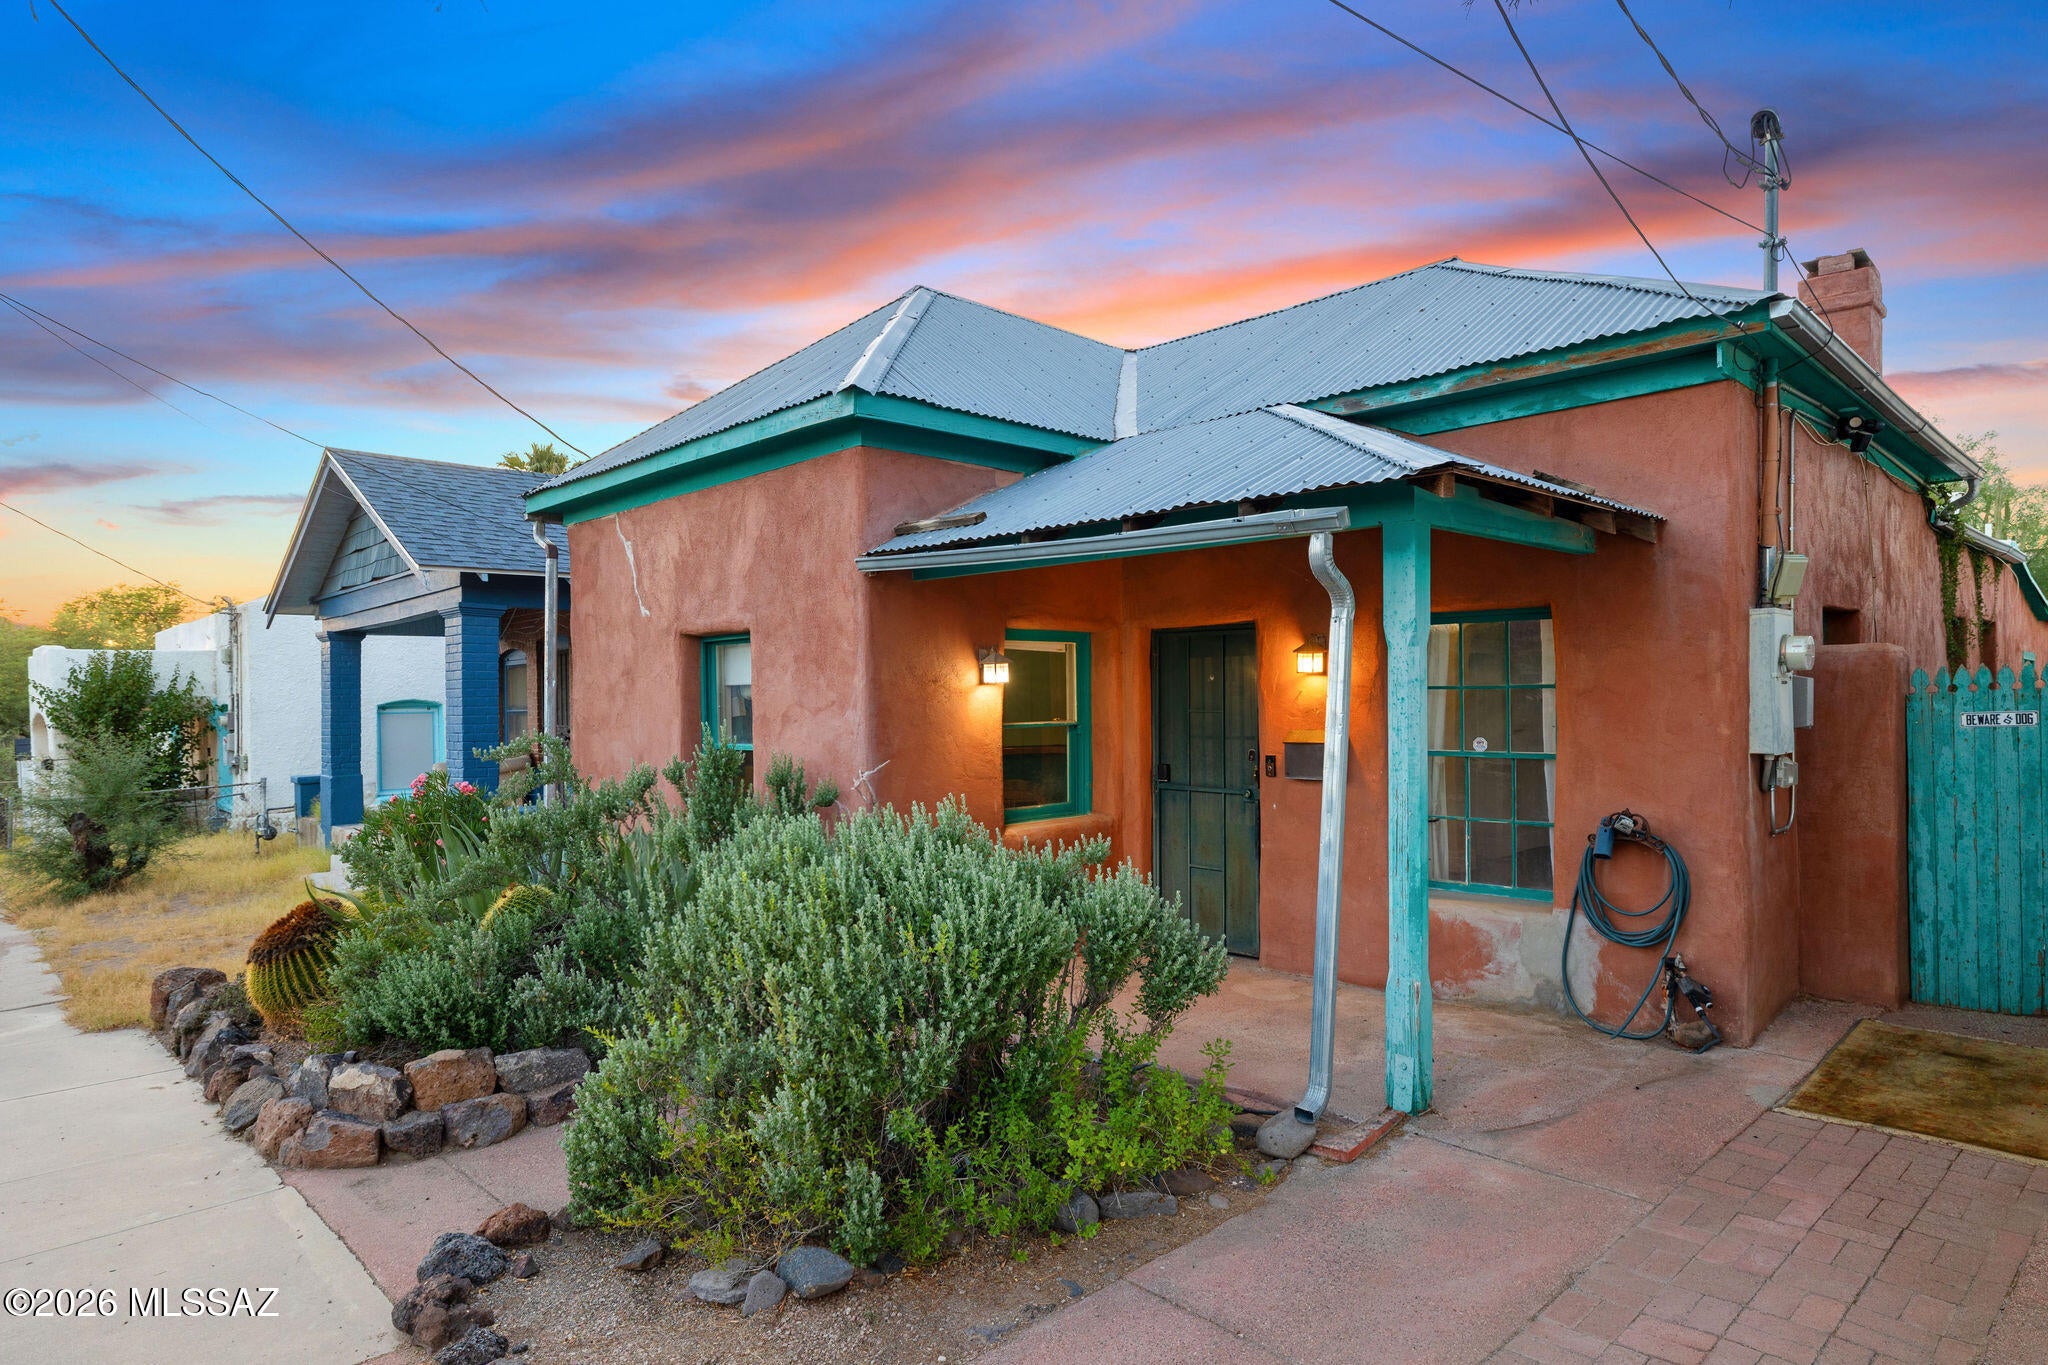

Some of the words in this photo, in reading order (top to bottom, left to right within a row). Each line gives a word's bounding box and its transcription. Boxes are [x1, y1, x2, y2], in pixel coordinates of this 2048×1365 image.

[1966, 713, 2001, 725] BEWARE
[2003, 714, 2013, 724] OF
[2015, 713, 2033, 724] DOG
